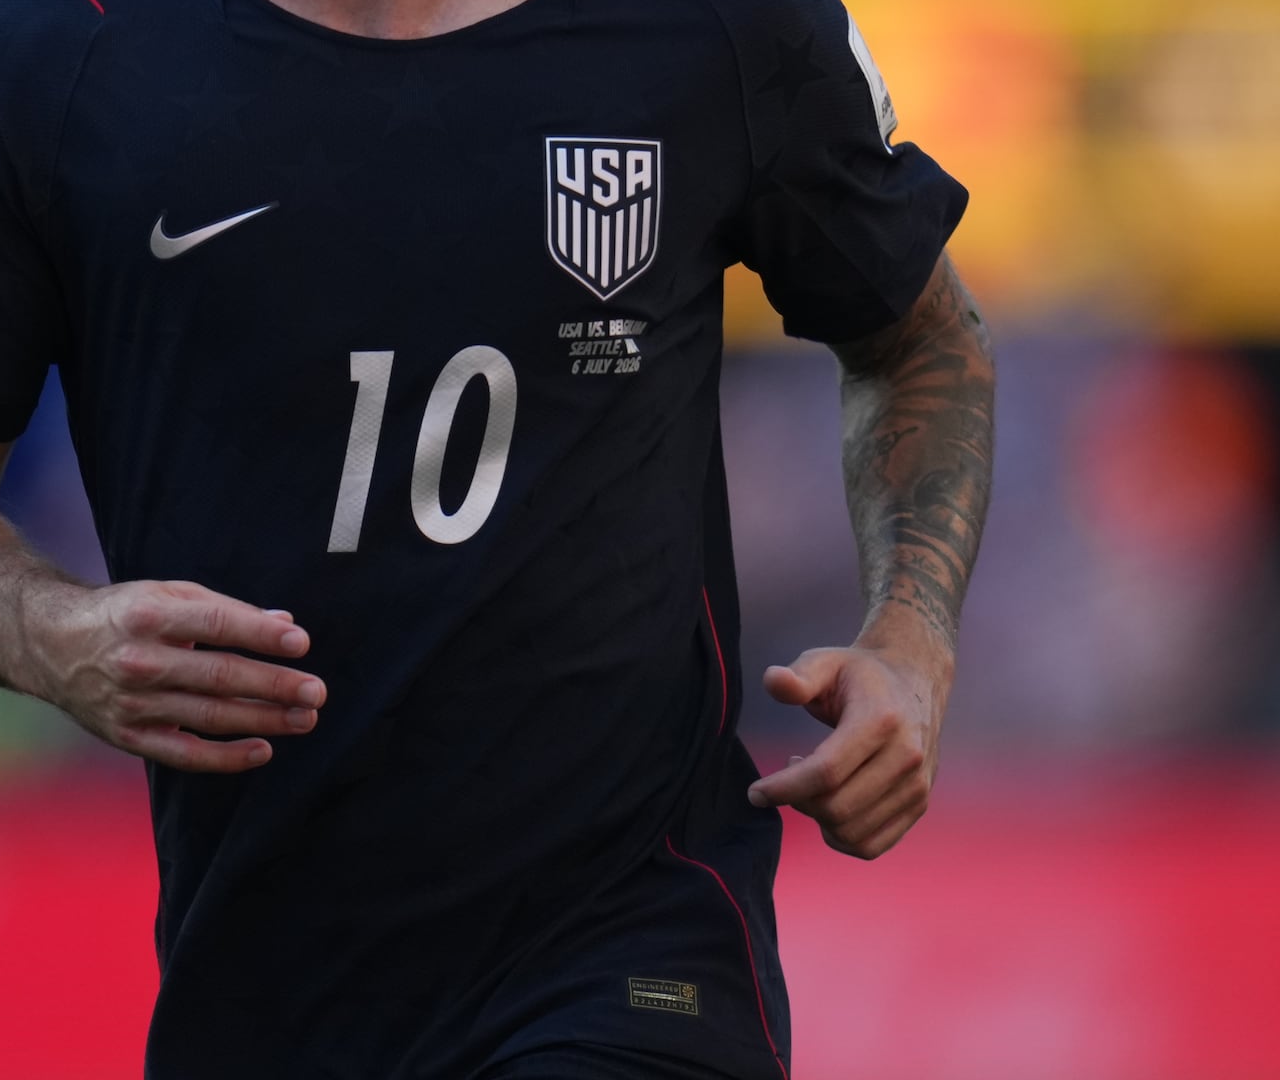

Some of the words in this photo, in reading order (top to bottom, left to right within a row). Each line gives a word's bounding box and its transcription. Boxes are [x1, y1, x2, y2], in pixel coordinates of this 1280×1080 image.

[557, 148, 652, 207] USA
[558, 322, 583, 338] USA
[587, 320, 606, 337] VS.
[569, 339, 623, 356] SEATTLE,
[571, 359, 581, 375] 6
[582, 358, 613, 375] JULY
[614, 356, 642, 374] 2026
[327, 345, 518, 552] 10
[632, 982, 679, 993] ENGINEERED
